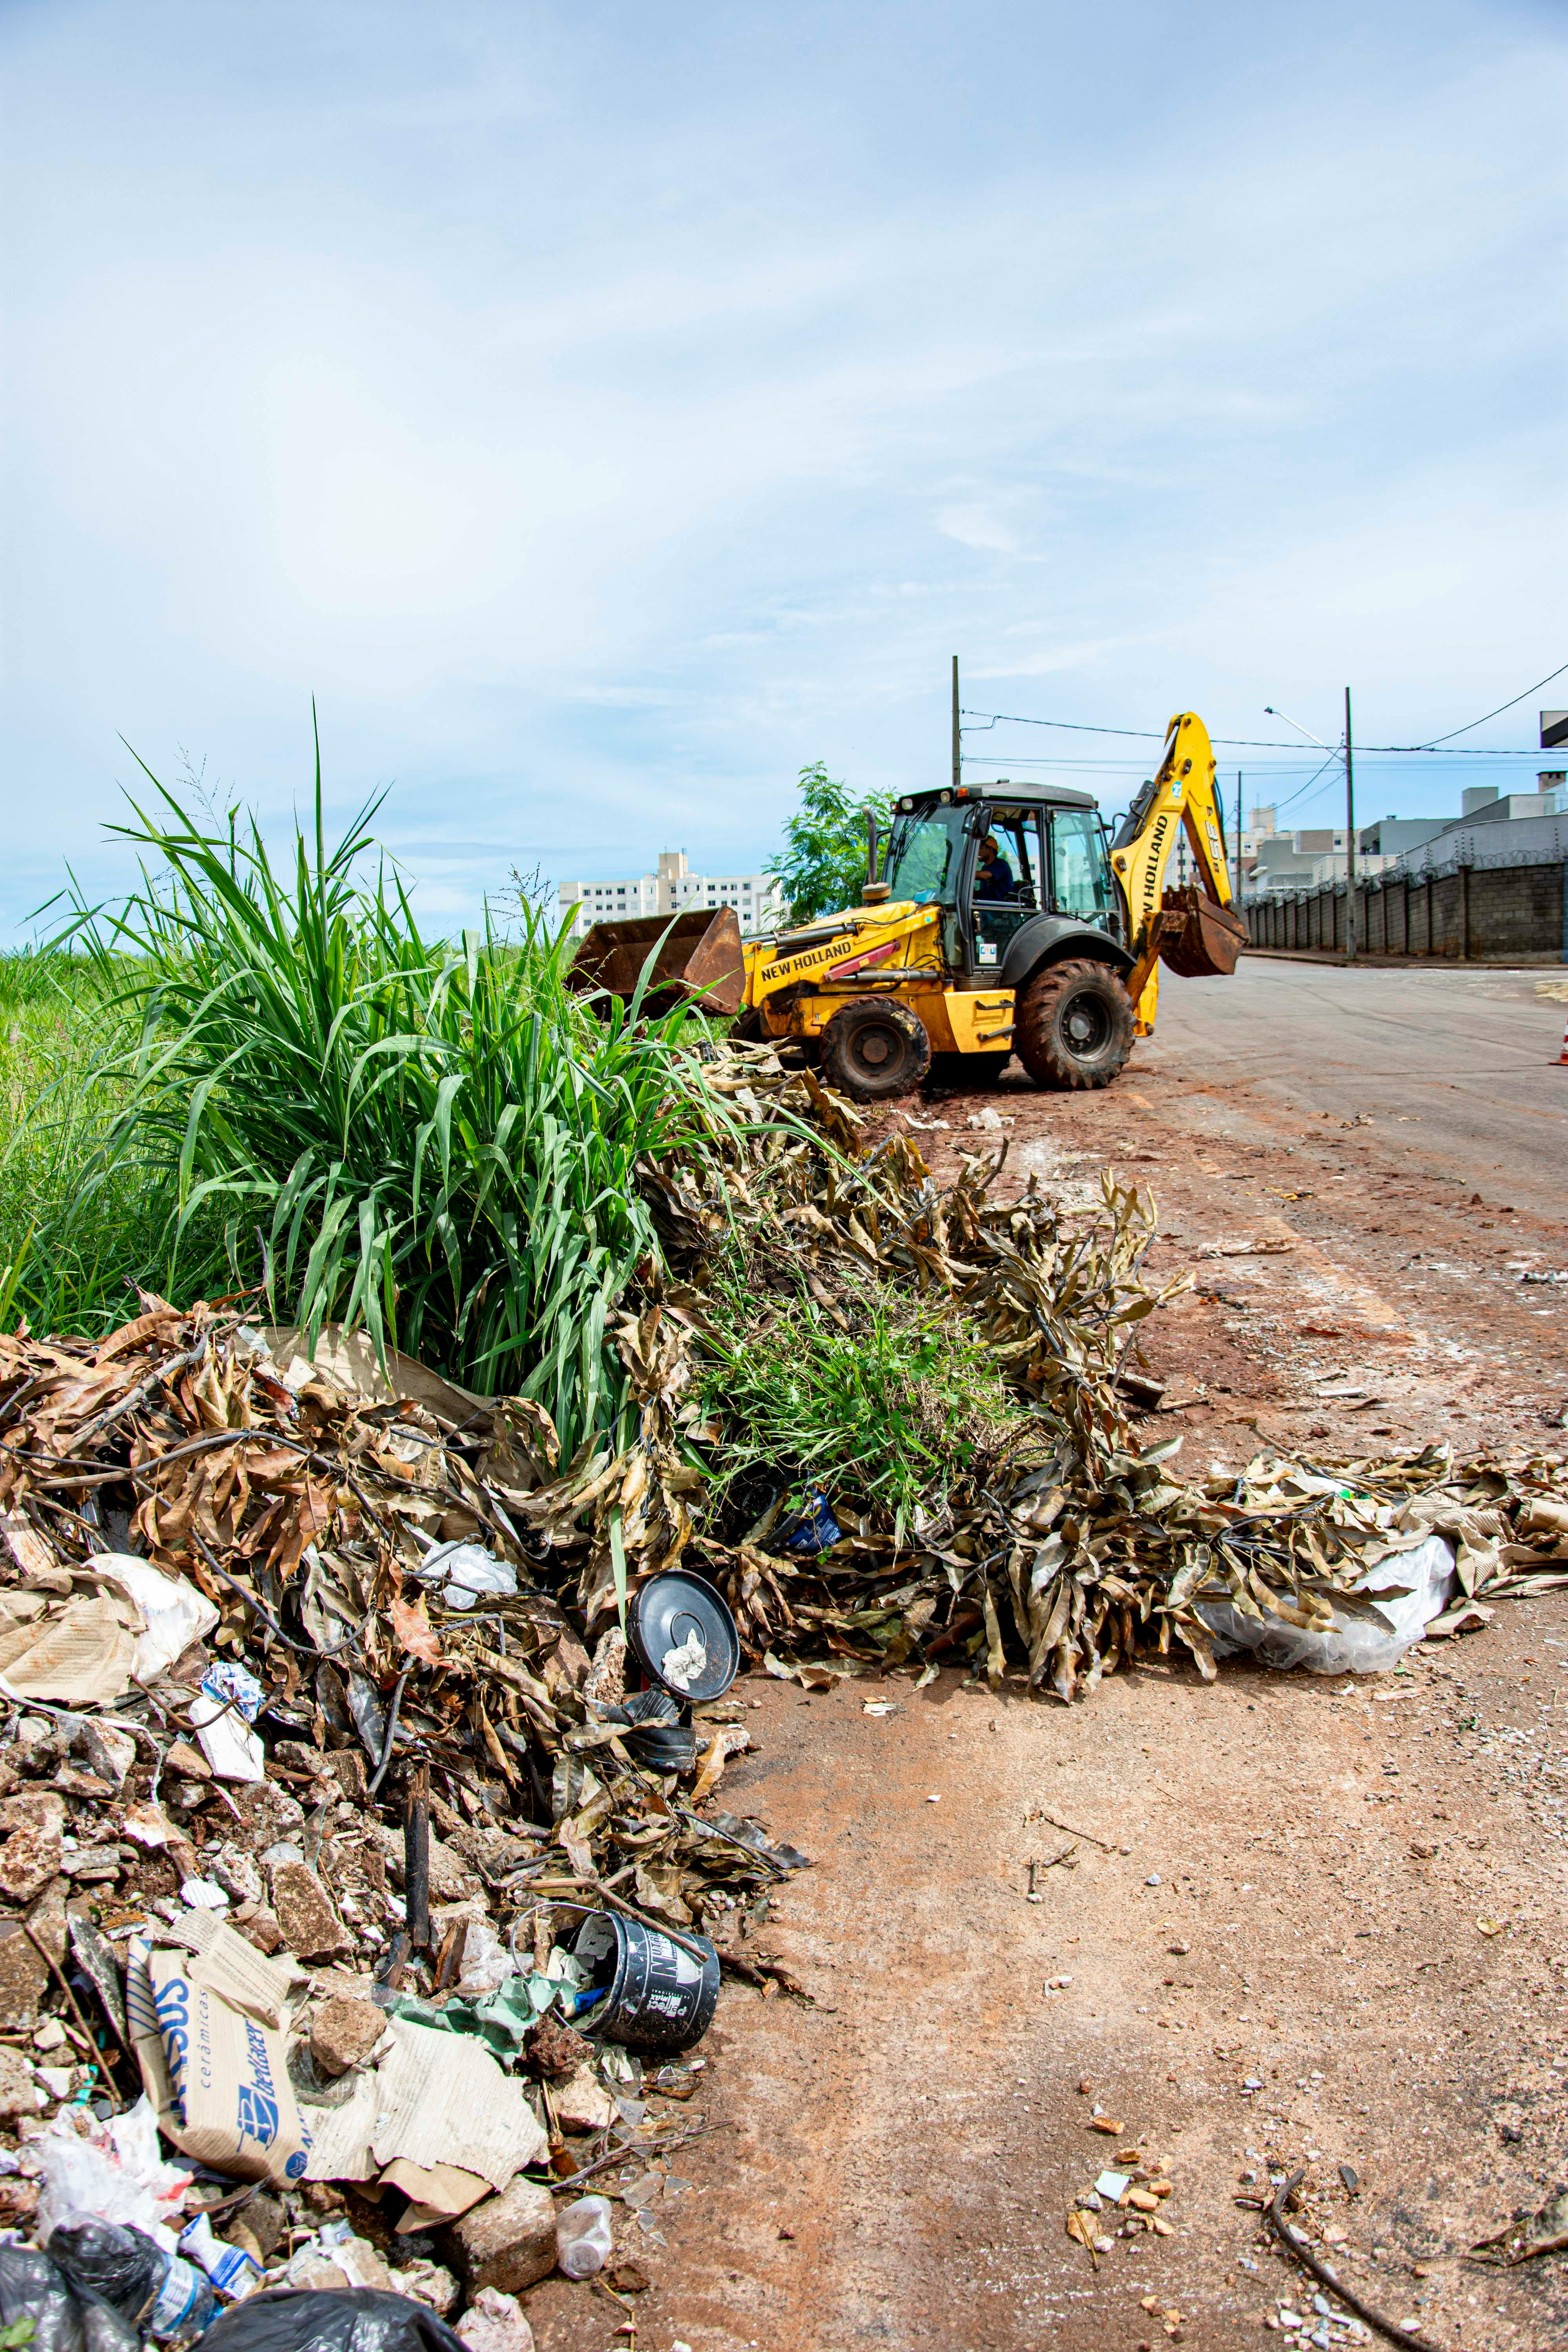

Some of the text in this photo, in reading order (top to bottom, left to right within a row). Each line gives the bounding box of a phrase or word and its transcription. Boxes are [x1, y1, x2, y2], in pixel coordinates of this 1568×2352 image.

[1144, 815, 1167, 898] HOLLAND
[761, 942, 851, 982] NEW HOLLAND
[650, 1994, 669, 2002] max
[652, 1989, 690, 1999] PROFESSIONAL
[197, 1989, 211, 2089] cerâmicas
